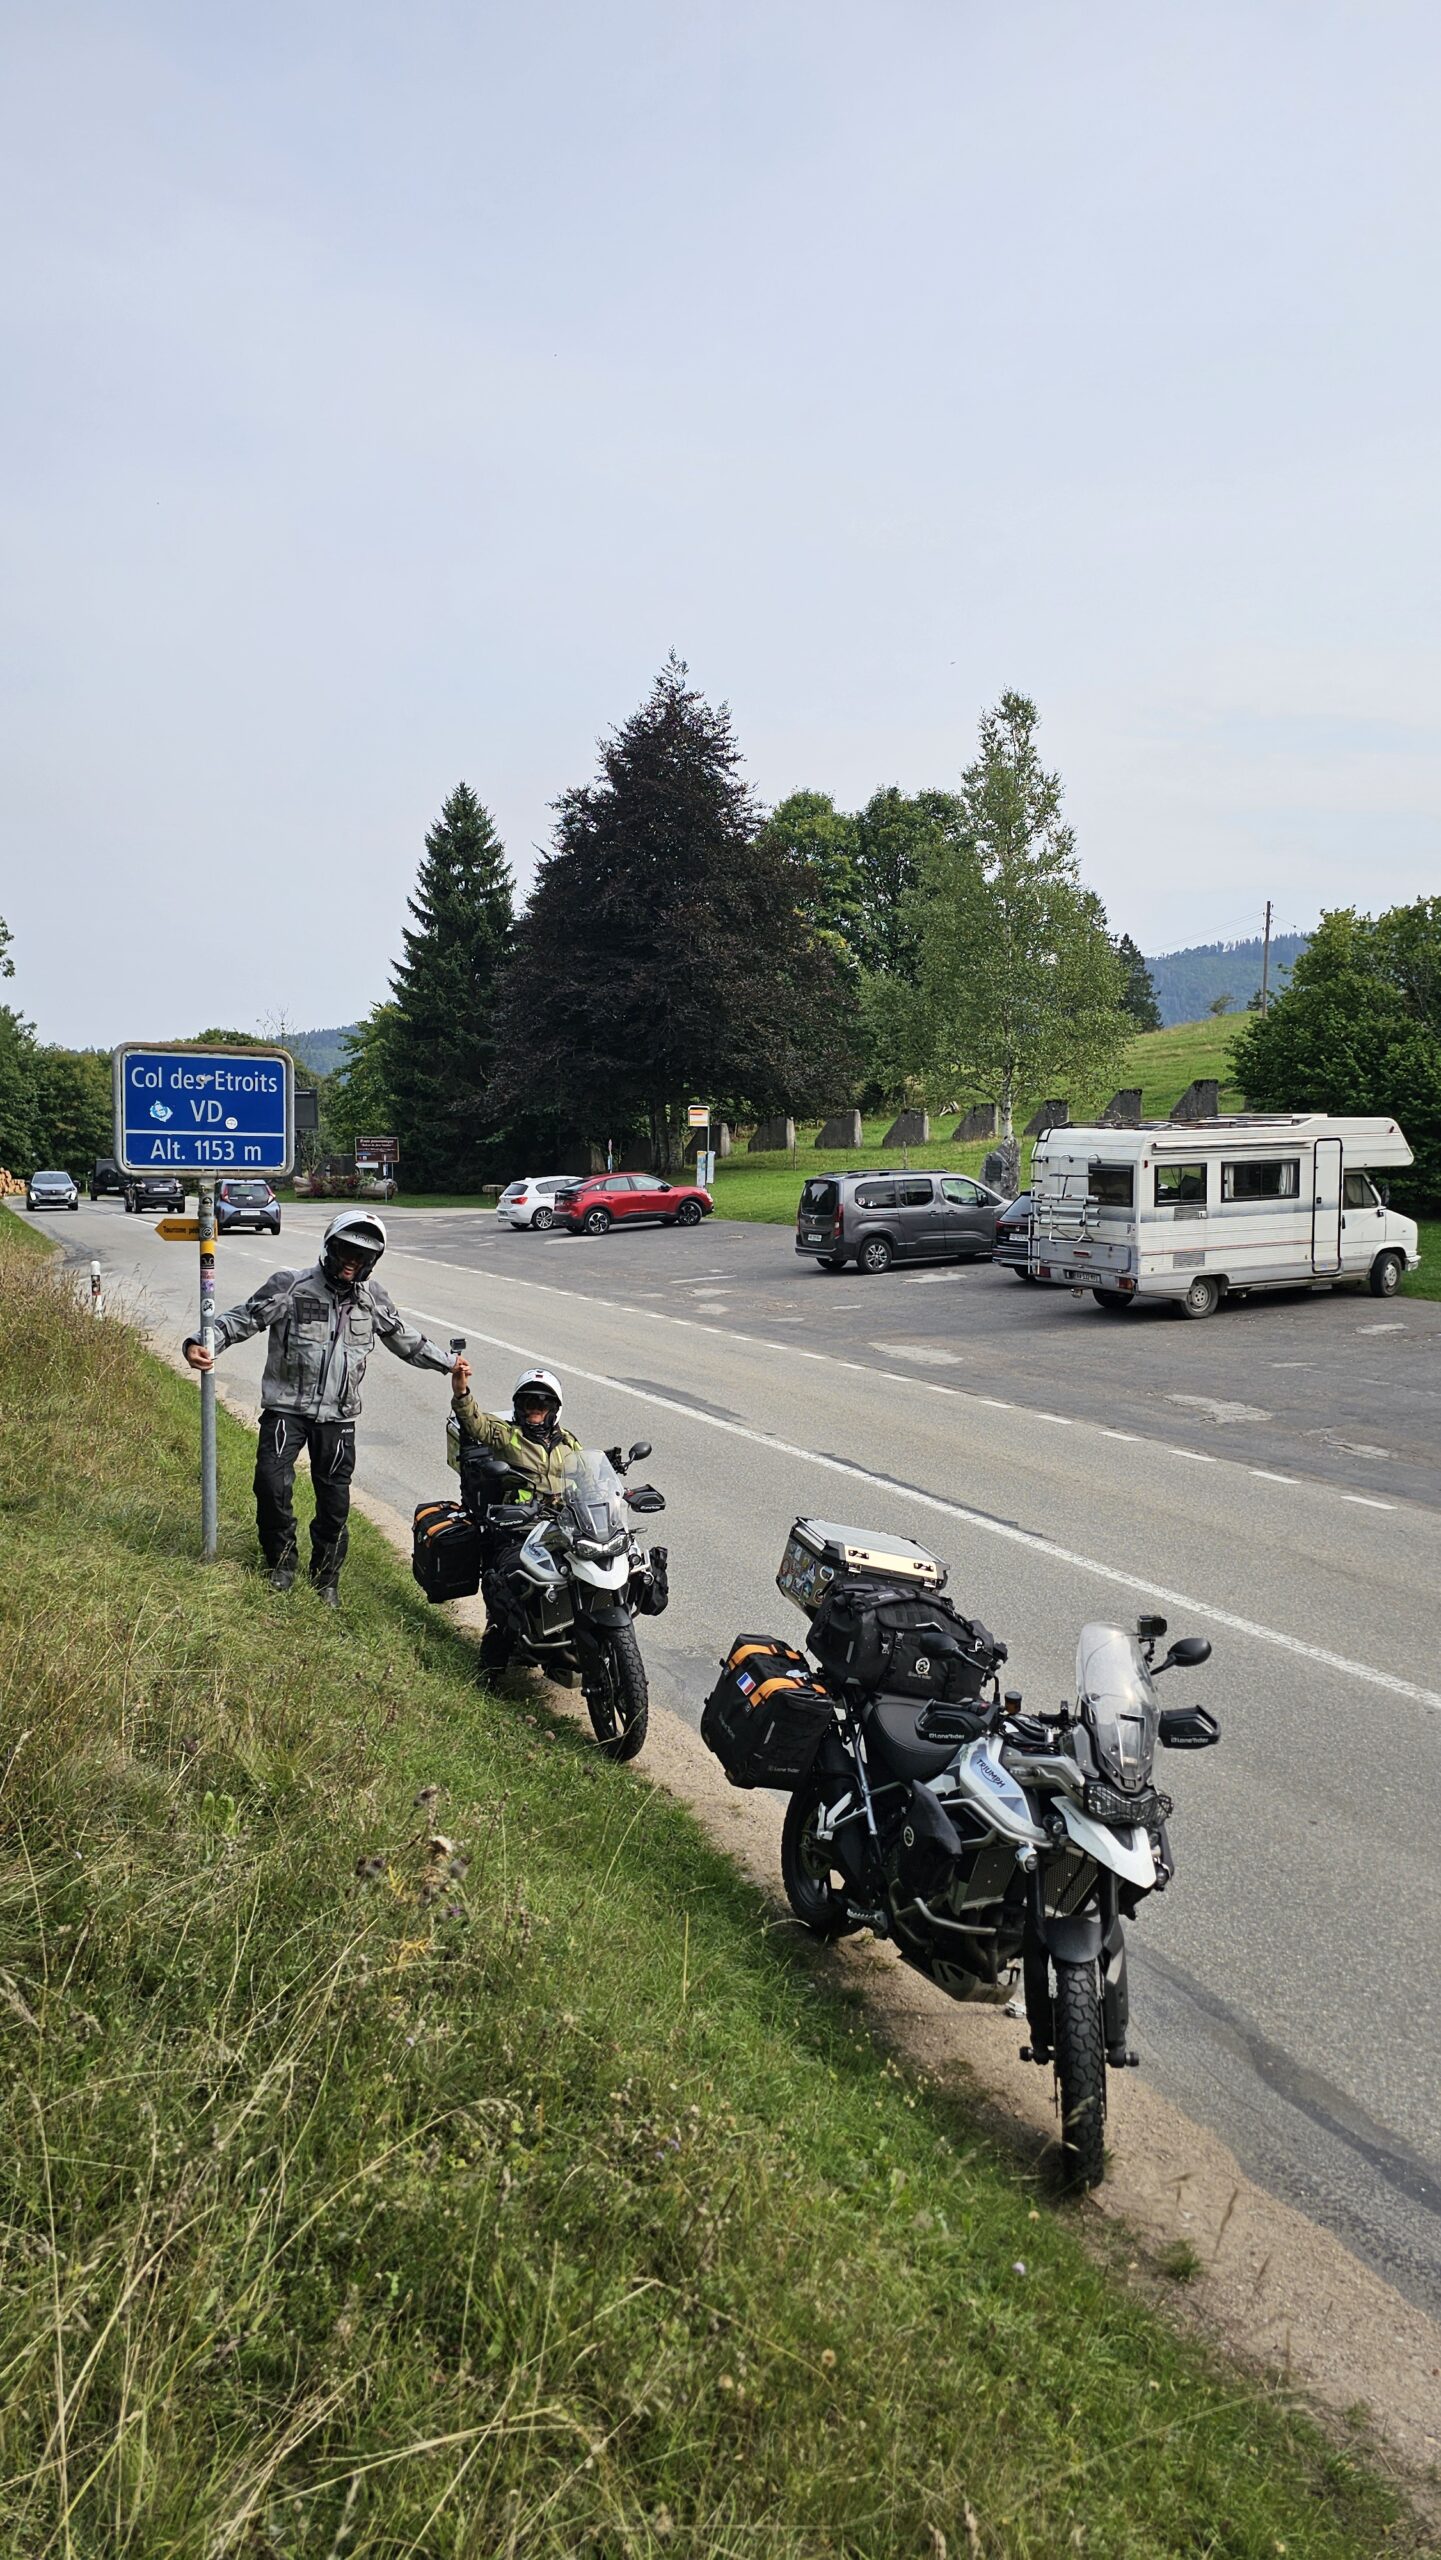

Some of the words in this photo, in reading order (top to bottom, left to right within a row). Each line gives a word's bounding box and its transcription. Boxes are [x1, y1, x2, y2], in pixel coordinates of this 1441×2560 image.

[131, 1067, 163, 1089] Col
[170, 1067, 205, 1090] des
[214, 1070, 278, 1093] Etroits
[189, 1099, 223, 1123] VD
[150, 1138, 186, 1160] Alt.
[194, 1140, 235, 1161] 1153
[244, 1145, 262, 1161] m
[976, 1758, 1006, 1788] TRIUMPH
